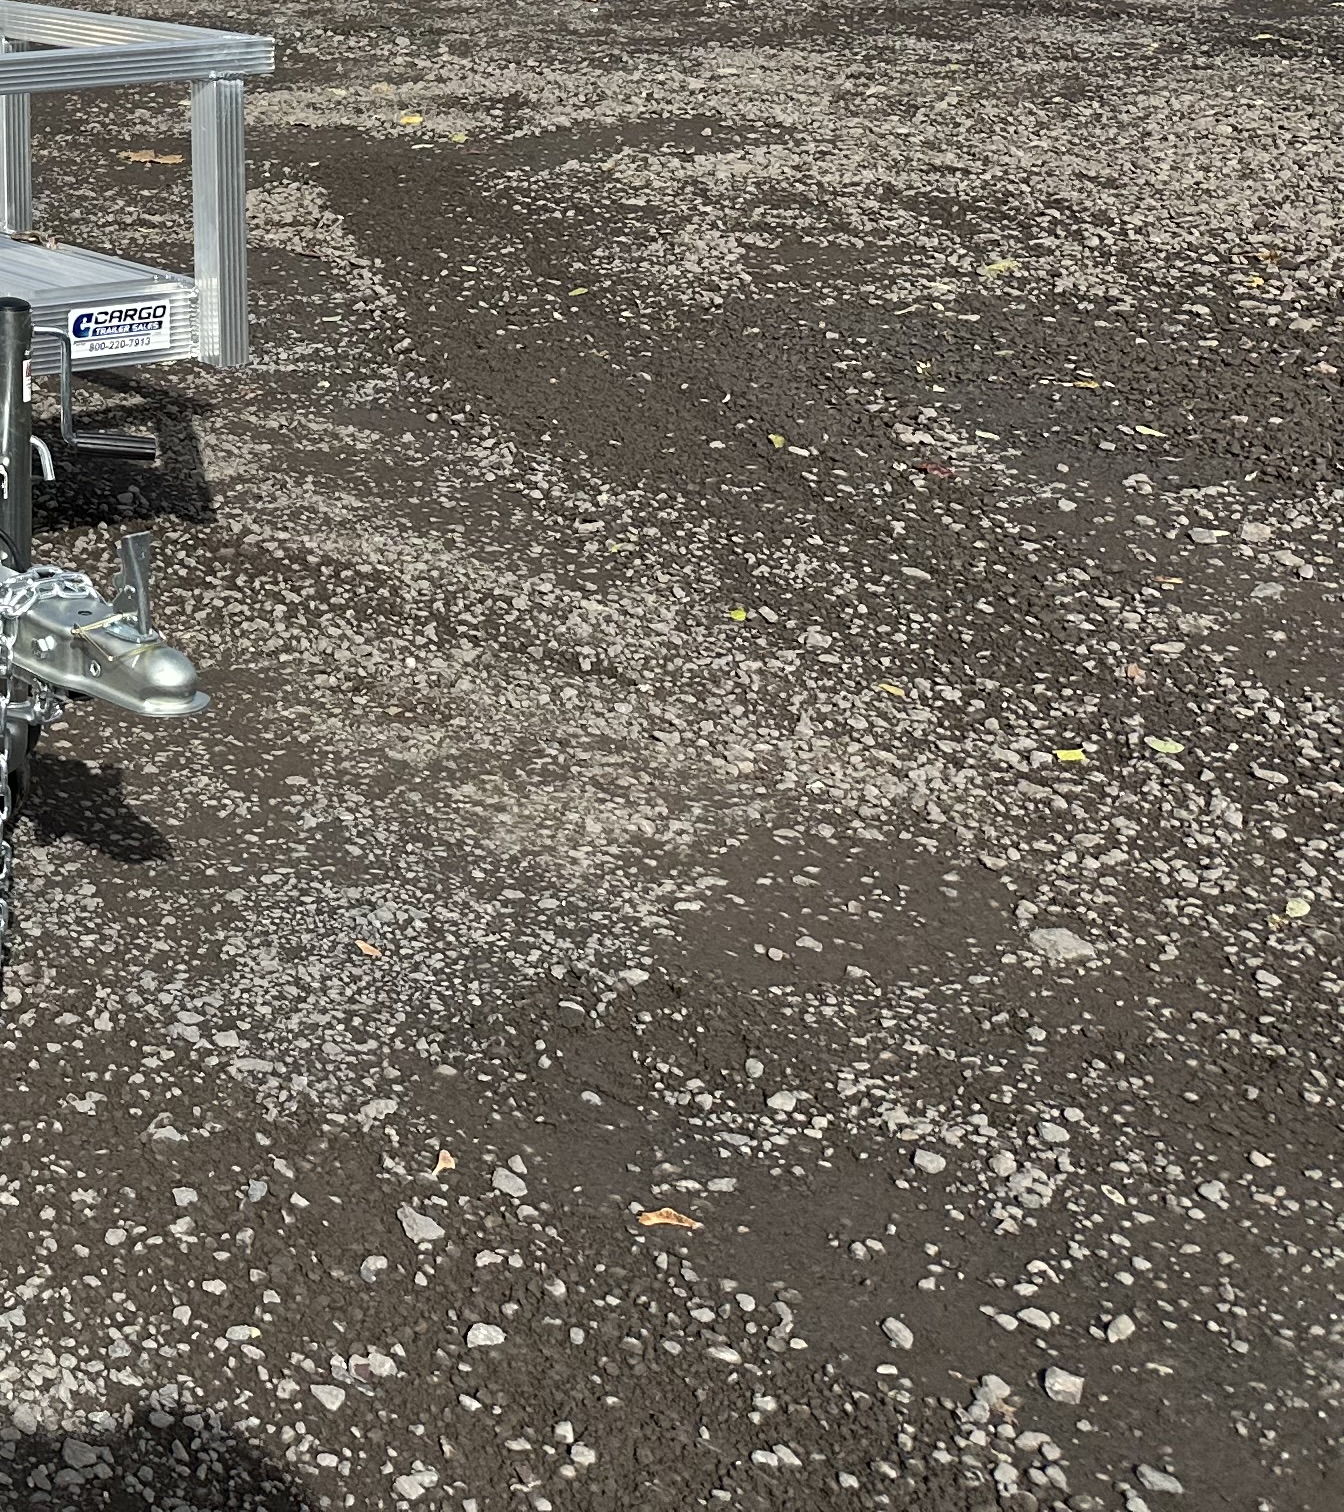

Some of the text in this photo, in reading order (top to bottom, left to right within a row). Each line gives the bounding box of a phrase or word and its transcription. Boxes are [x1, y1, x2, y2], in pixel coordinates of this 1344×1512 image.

[94, 305, 167, 324] CARGO
[95, 321, 160, 336] TRAILER SALES
